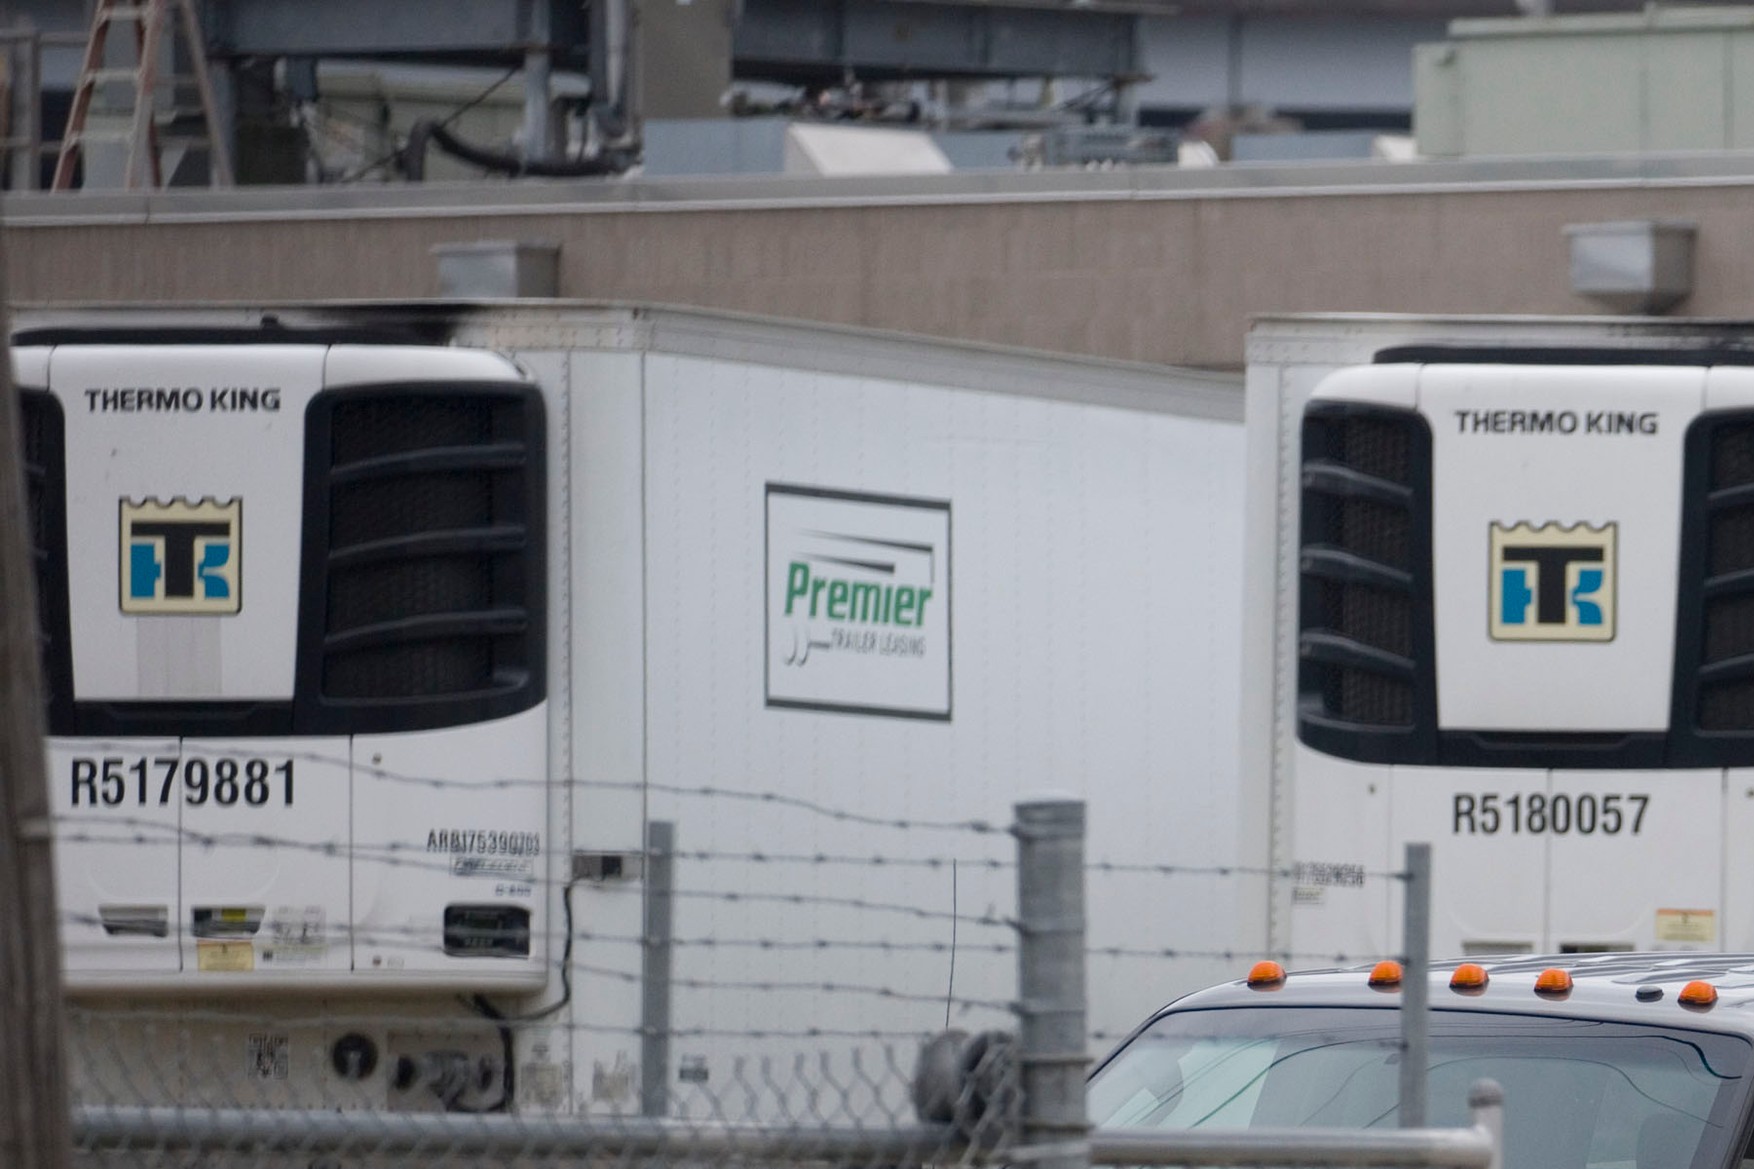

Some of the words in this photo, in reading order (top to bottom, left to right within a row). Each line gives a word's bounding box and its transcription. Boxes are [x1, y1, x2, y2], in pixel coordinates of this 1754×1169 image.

[85, 388, 202, 412] THERMO
[210, 388, 281, 413] KING
[1455, 411, 1578, 434] THERMO
[1587, 411, 1659, 434] KING
[785, 561, 933, 627] Premier
[71, 757, 294, 808] R5179881
[1453, 793, 1649, 835] R5180057
